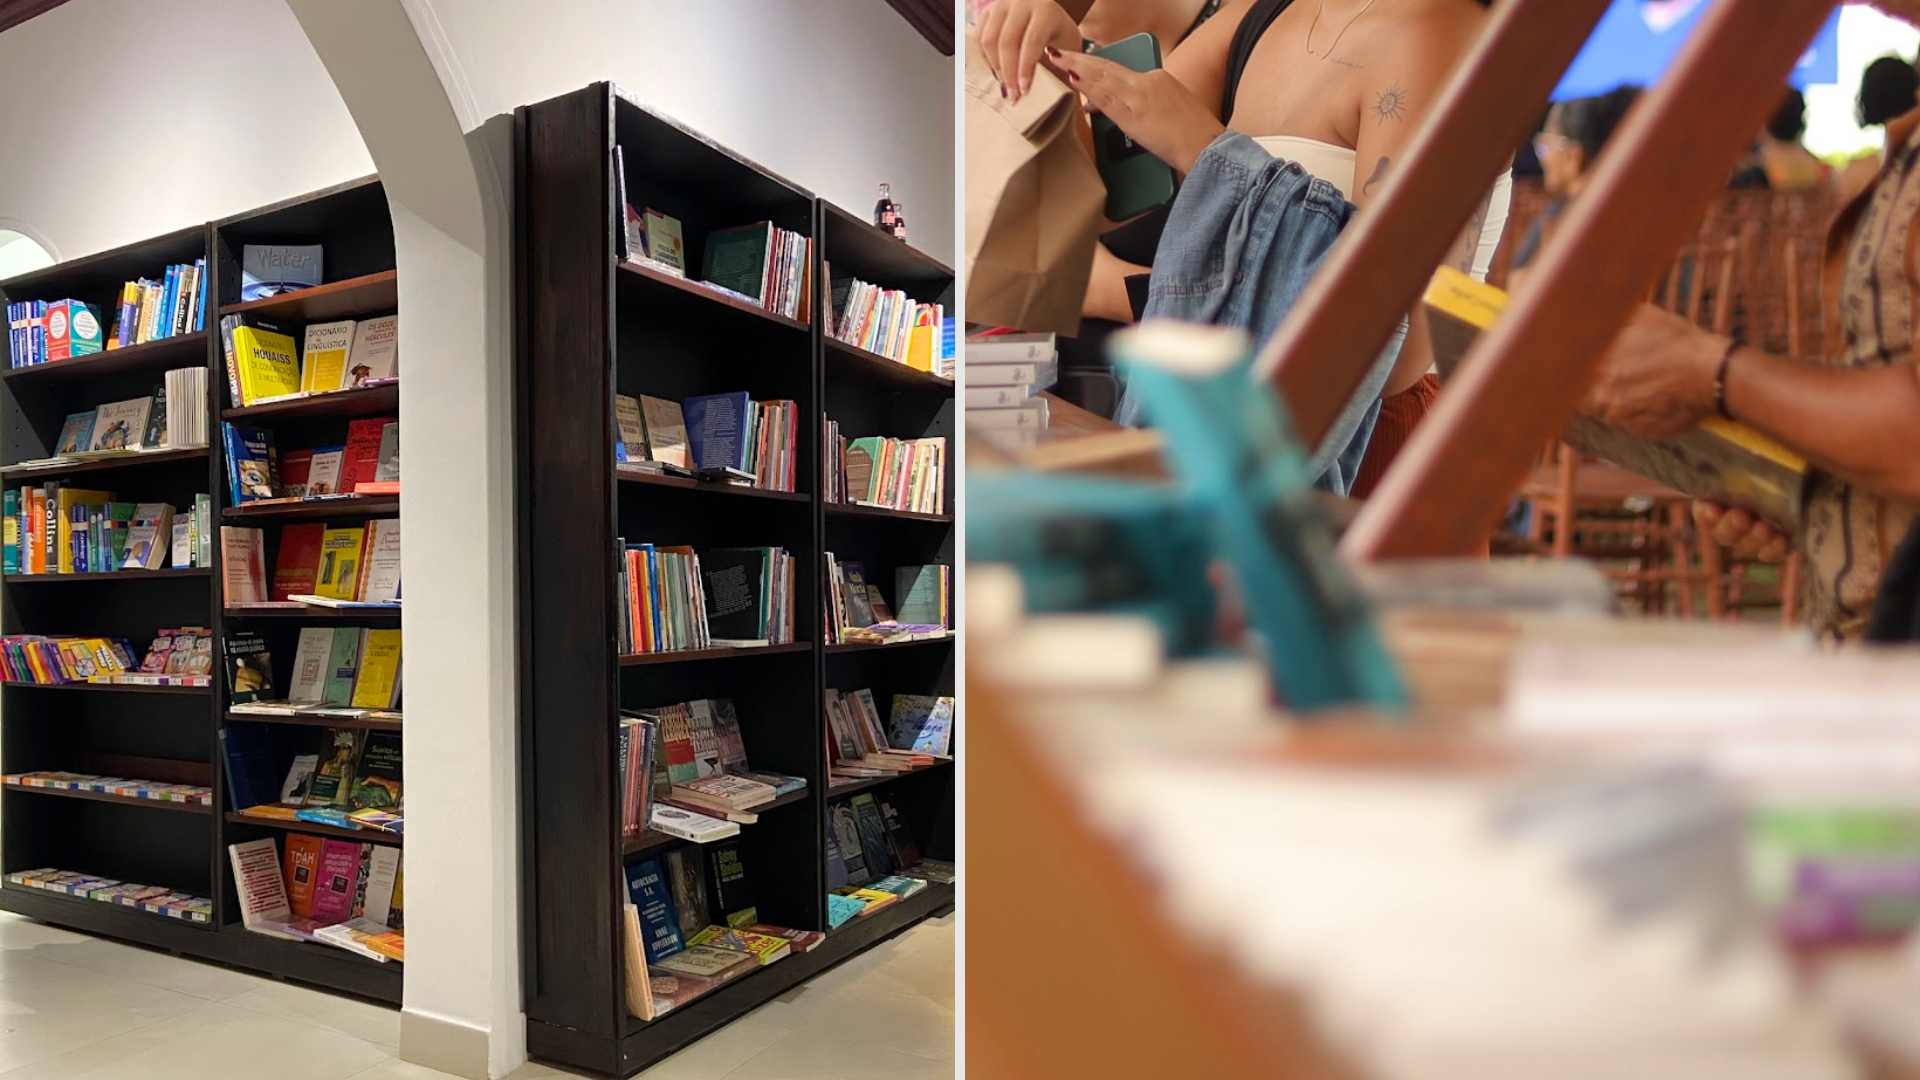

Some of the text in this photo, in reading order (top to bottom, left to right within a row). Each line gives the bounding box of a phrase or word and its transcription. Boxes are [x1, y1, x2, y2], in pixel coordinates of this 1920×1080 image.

[256, 248, 311, 269] Water
[178, 298, 186, 328] Collins
[309, 326, 348, 337] DICIONÁRIO
[368, 323, 376, 331] OS
[377, 321, 394, 329] DOZE
[307, 339, 347, 350] LINGUÍSTICA
[253, 347, 291, 365] HOUAISS
[102, 405, 142, 419] The Journey
[46, 499, 56, 553] Collins
[291, 850, 315, 865] TDAH
[631, 873, 659, 890] AUTOCRACIA
[654, 926, 668, 938] ANNE
[651, 933, 679, 952] APPLEBAUM
